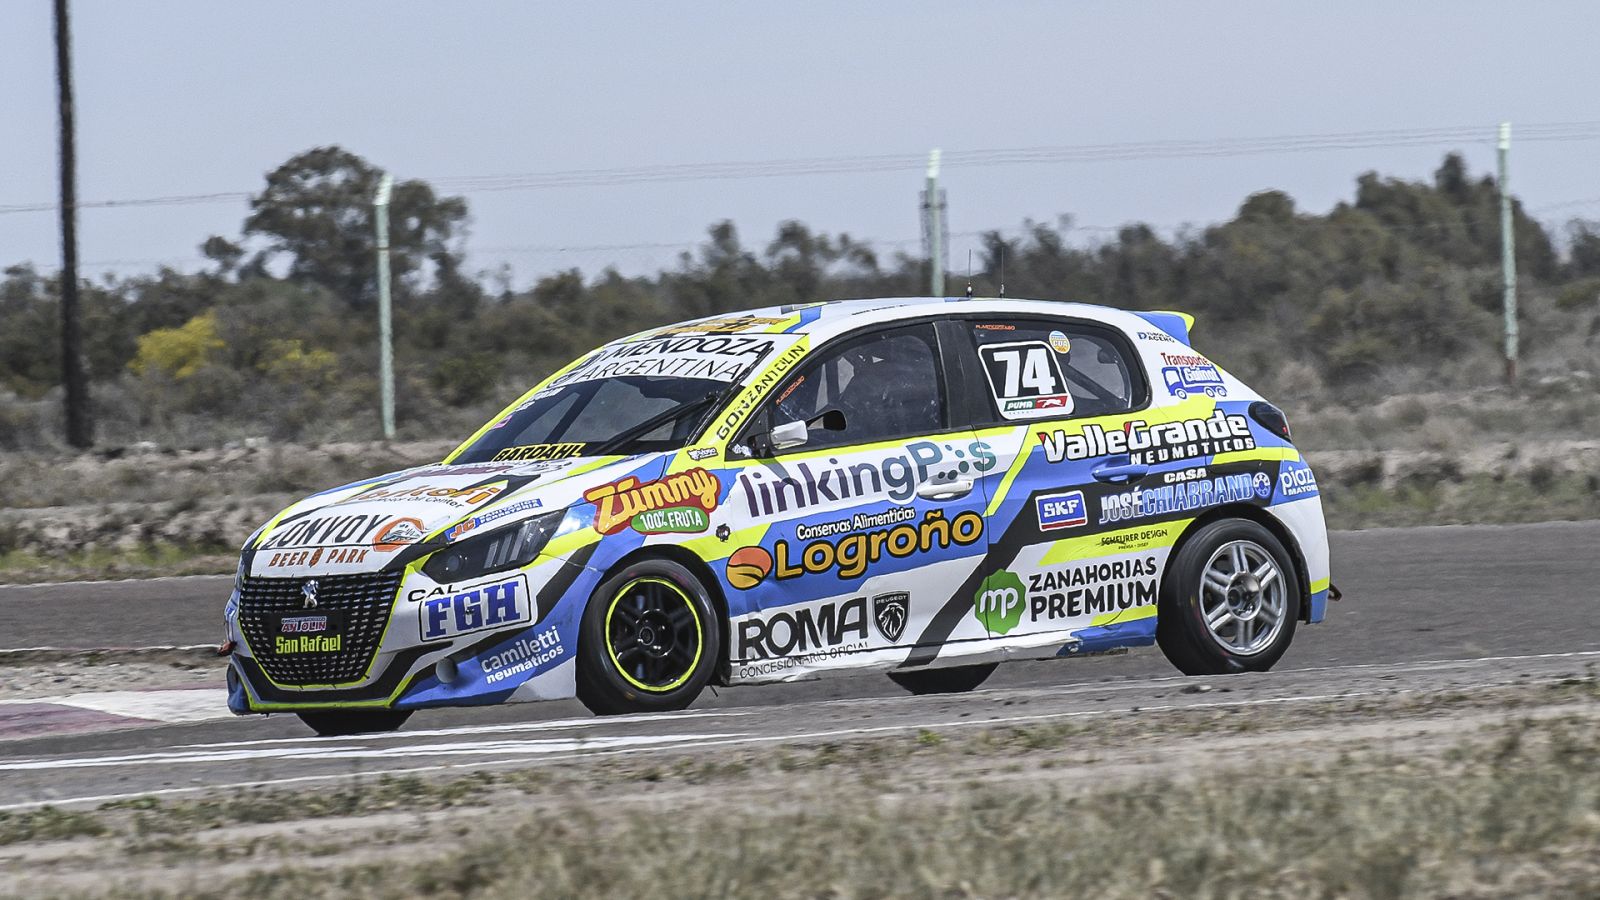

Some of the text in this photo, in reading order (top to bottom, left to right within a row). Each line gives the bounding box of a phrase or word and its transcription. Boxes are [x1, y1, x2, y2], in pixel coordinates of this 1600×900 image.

[601, 338, 775, 361] MENDOZA
[574, 358, 743, 382] ARGENTINA
[993, 348, 1056, 397] 74
[1007, 400, 1033, 410] PUMA
[493, 443, 586, 462] BARDAHL
[1131, 438, 1255, 465] NEUMATICOS
[1164, 468, 1206, 483] CASA
[426, 497, 464, 508] Center
[1043, 499, 1079, 518] SKF
[640, 509, 703, 530] 100% FRUTA
[797, 507, 915, 540] Conservas Alimenticias
[775, 510, 984, 580] Logroño
[269, 550, 370, 567] BEER PARK
[1029, 557, 1156, 592] ZANAHORIAS
[408, 585, 460, 602] CAL
[876, 595, 907, 604] PEUGEOT
[1031, 579, 1157, 622] PREMIUM
[425, 581, 520, 638] FGH
[282, 621, 326, 632] ANTOLIN
[738, 597, 868, 666] ROMA
[276, 634, 341, 654] San Rafael
[481, 626, 561, 673] camiletti
[487, 644, 564, 684] neumáticos
